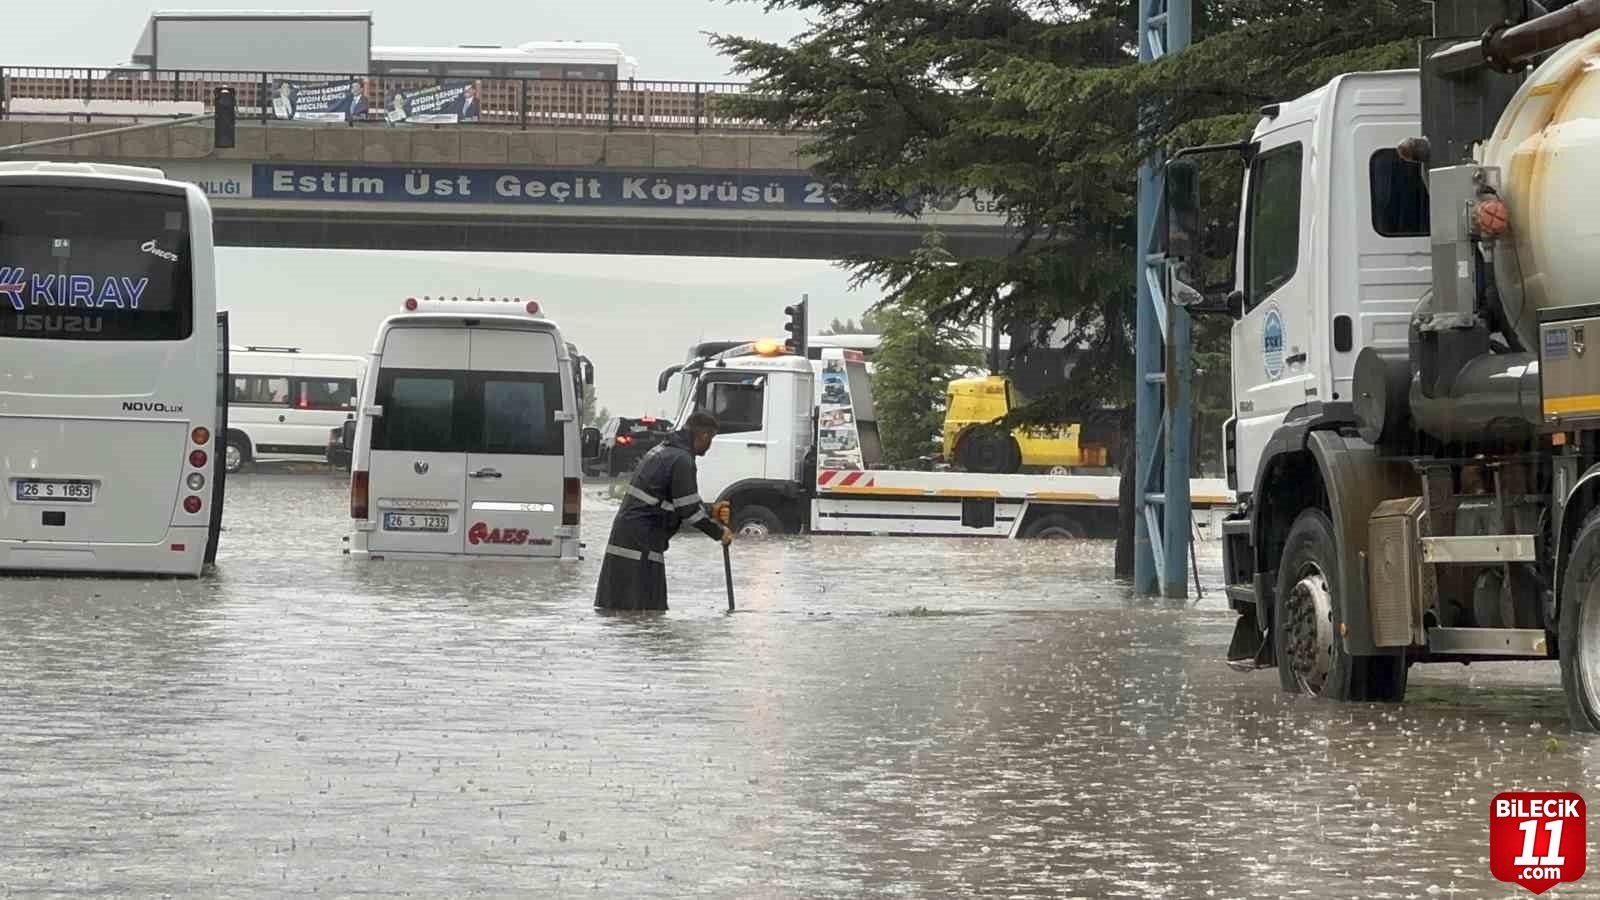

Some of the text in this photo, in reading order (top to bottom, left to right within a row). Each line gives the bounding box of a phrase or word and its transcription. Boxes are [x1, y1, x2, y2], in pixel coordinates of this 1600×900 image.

[197, 178, 240, 194] NLIĞI
[272, 170, 384, 194] Estim
[404, 169, 471, 196] Üst
[495, 175, 601, 202] Geçit
[622, 177, 785, 205] Köprüsü
[31, 273, 148, 309] KIRAY
[16, 314, 103, 332] ISUZU
[24, 484, 90, 497] 26 S 1853
[391, 516, 446, 528] 26 S 1239
